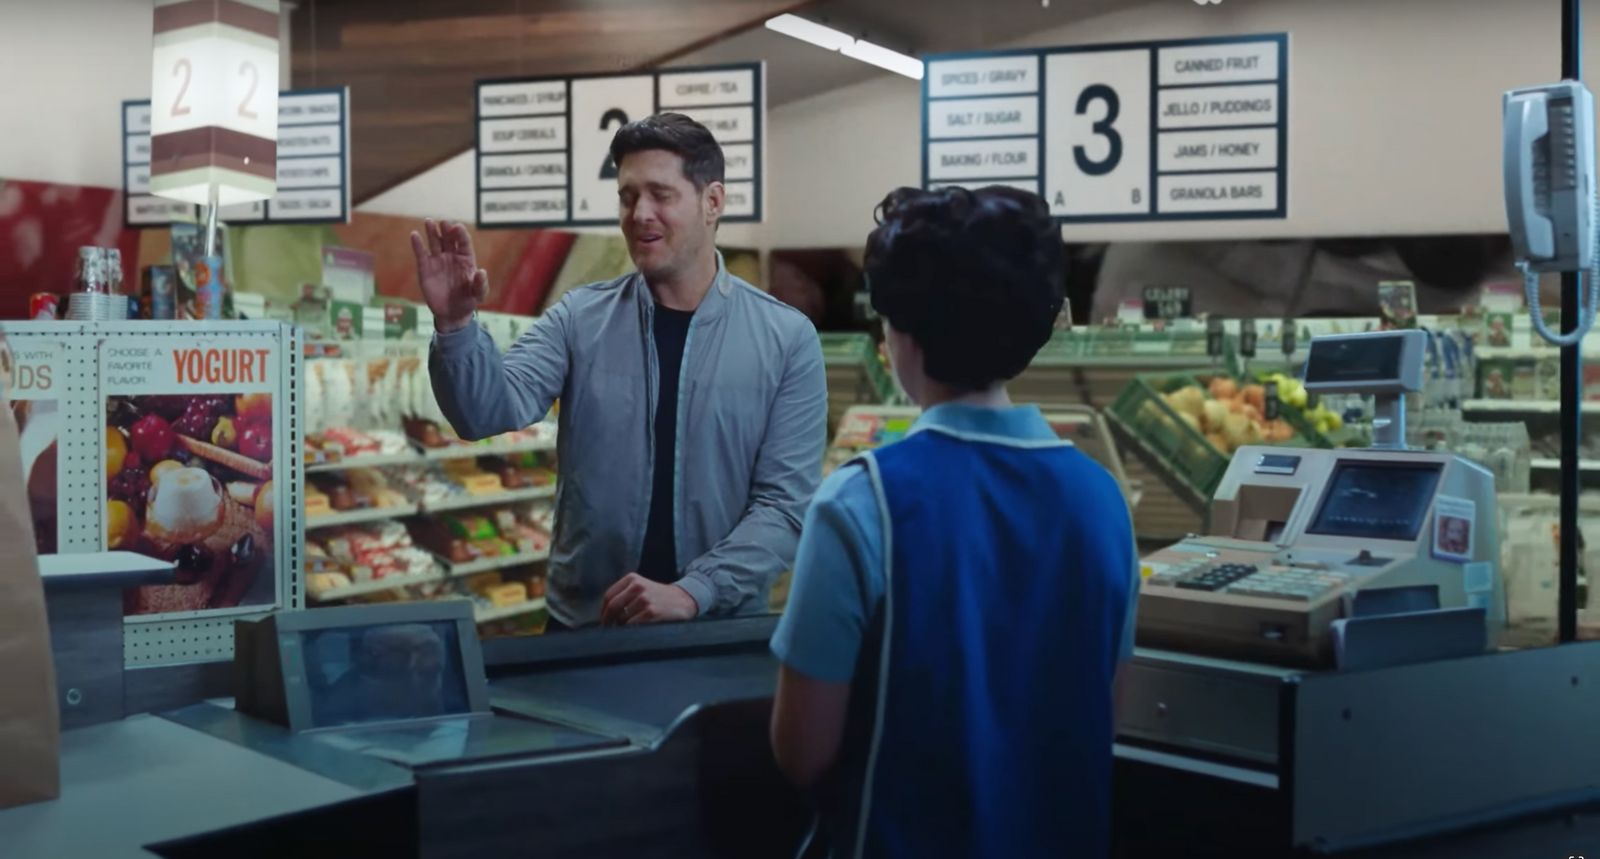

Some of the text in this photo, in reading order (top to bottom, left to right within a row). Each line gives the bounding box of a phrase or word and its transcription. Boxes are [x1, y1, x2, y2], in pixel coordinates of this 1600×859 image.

[1175, 57, 1259, 73] CANNED FRUIT
[941, 74, 979, 86] SPICES
[989, 70, 1026, 82] GRAVY
[170, 58, 192, 117] 2
[237, 60, 259, 119] 2
[720, 82, 738, 93] TEA
[1163, 103, 1199, 116] JELLO
[1210, 99, 1271, 113] PUDDINGS
[947, 115, 973, 125] SALT
[984, 111, 1021, 124] SUGAR
[1072, 83, 1123, 176] 3
[1174, 145, 1207, 158] JAMS
[1218, 142, 1260, 155] HONEY
[941, 154, 982, 167] BAKING
[991, 151, 1027, 164] FLOUR
[1054, 192, 1065, 206] A
[1131, 189, 1141, 204] B
[1170, 185, 1262, 201] GRANOLA BARS
[580, 200, 588, 211] A
[24, 351, 53, 361] WITH
[107, 348, 163, 358] CHOOSE A
[107, 361, 152, 371] FAVORITE
[173, 348, 270, 385] YOGURT
